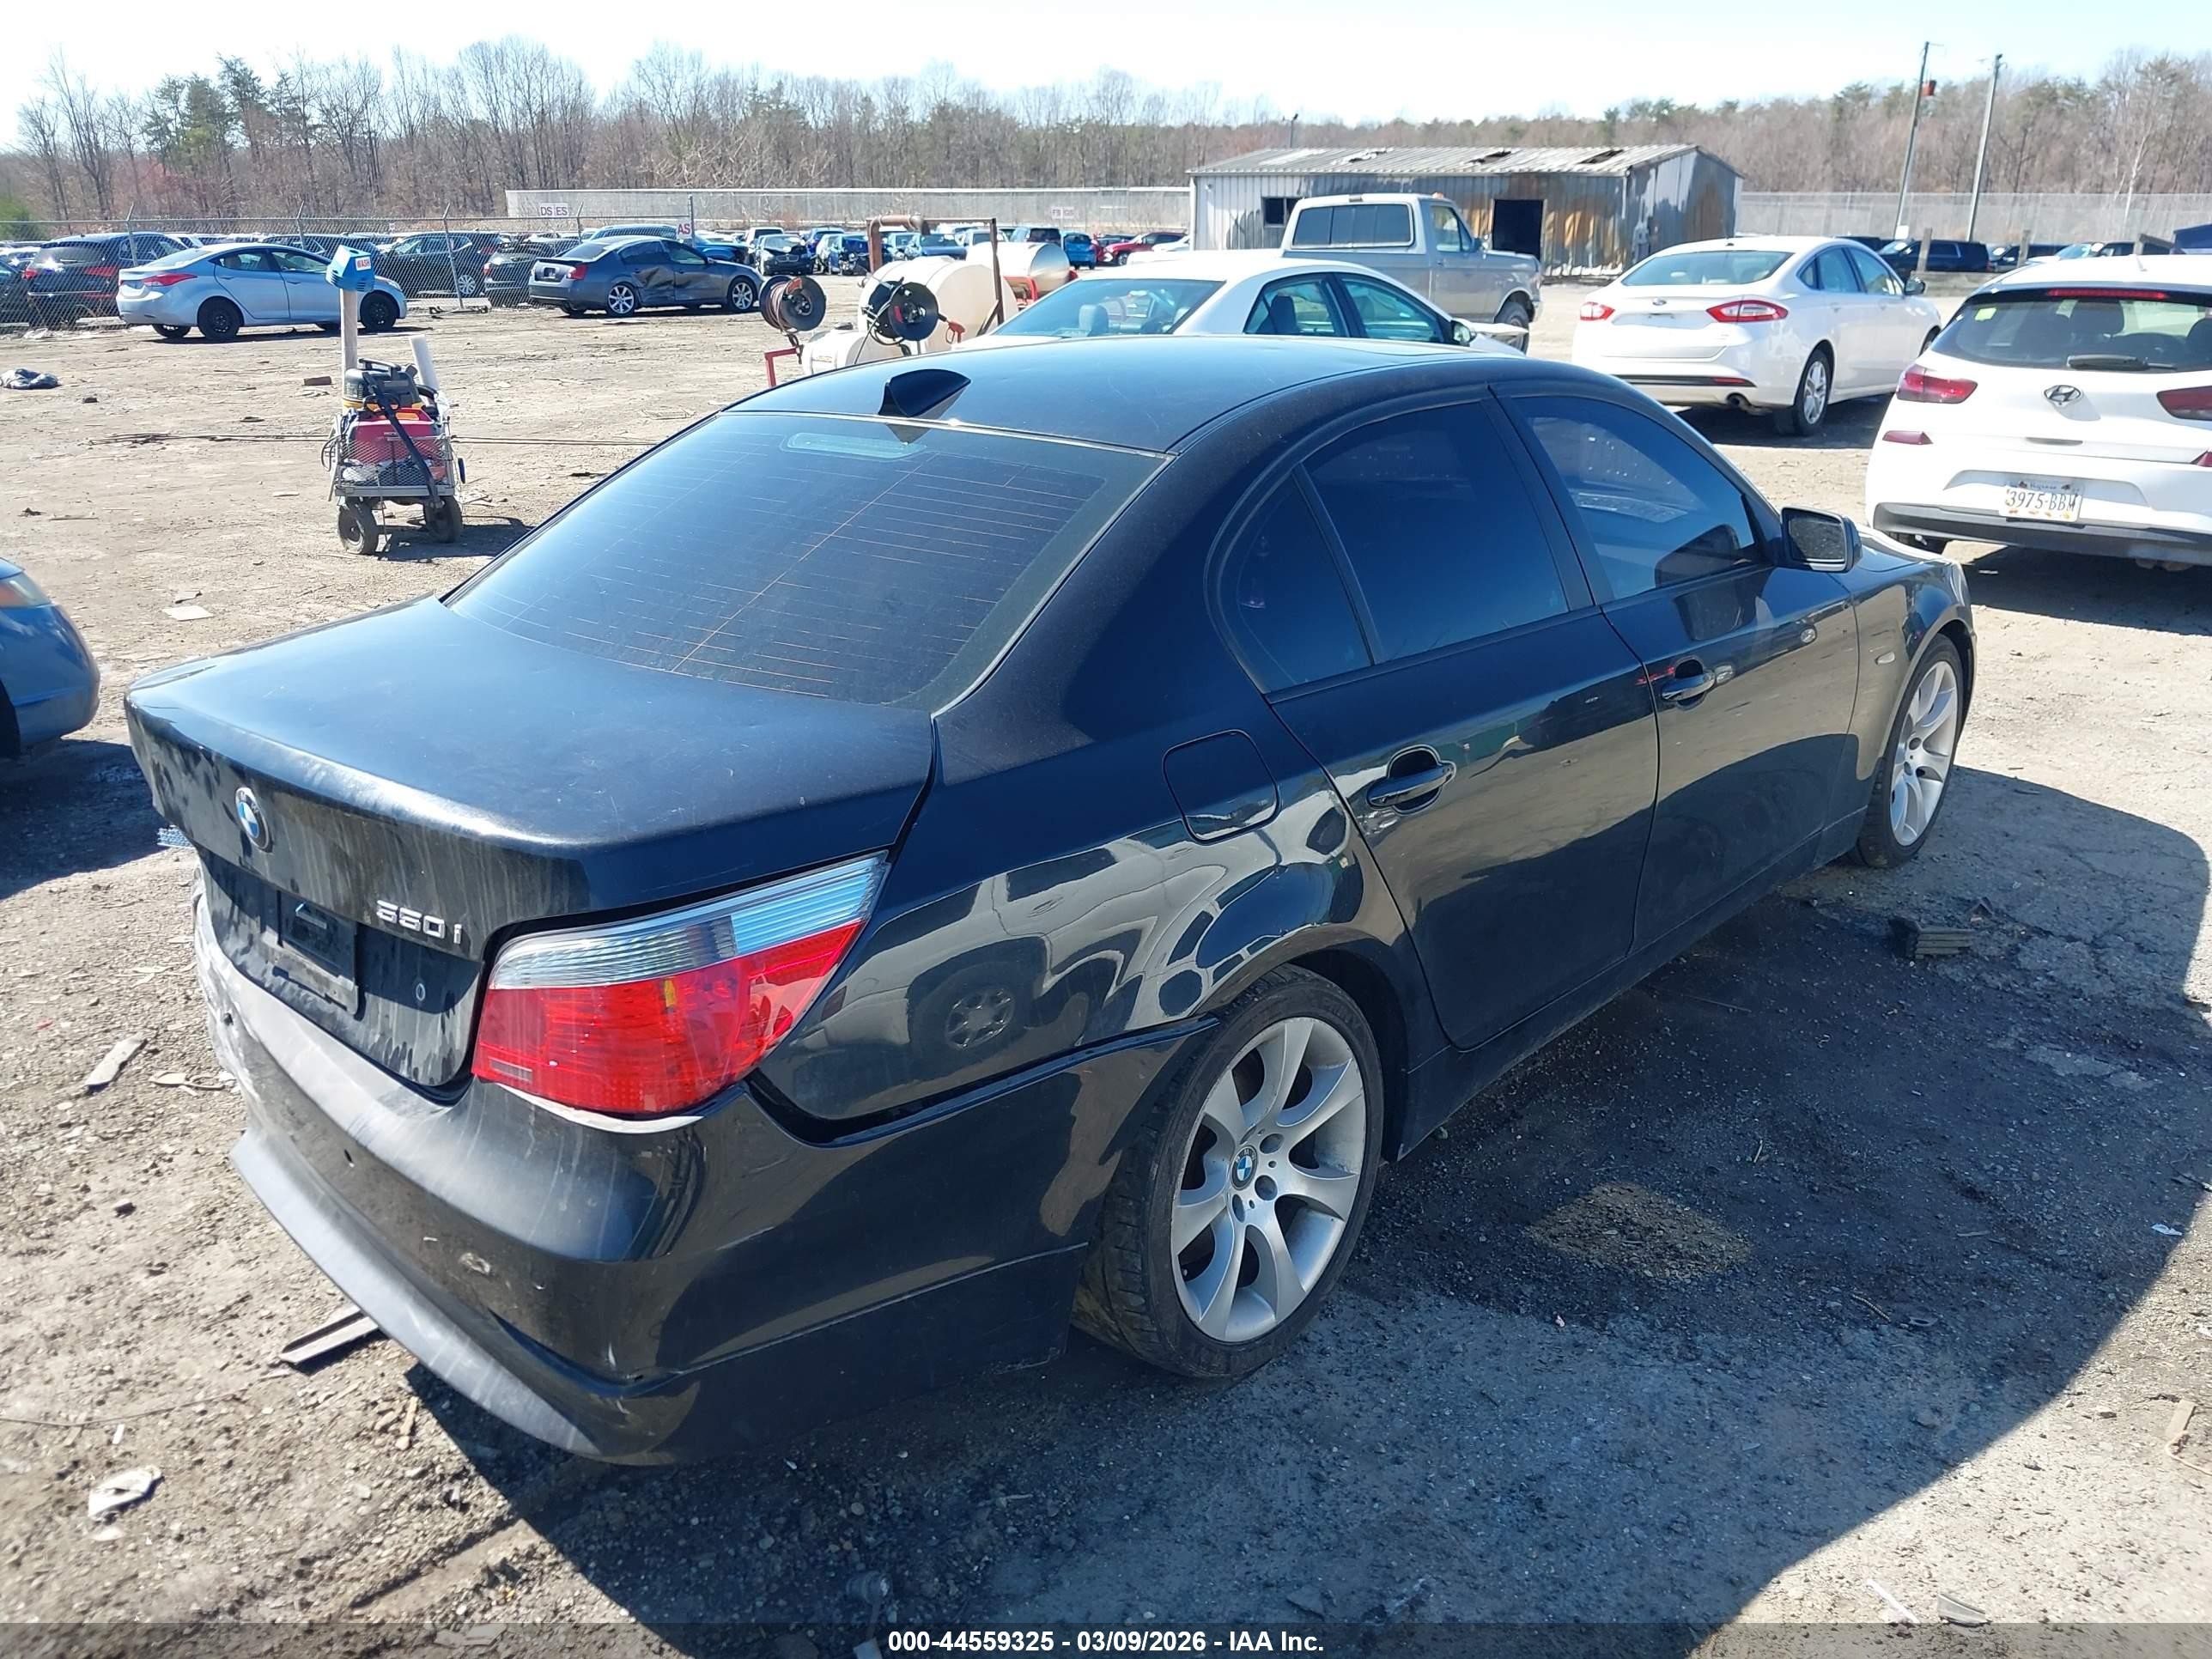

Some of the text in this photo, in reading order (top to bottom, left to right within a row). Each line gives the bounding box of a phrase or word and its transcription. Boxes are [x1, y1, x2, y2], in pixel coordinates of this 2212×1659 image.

[540, 206, 568, 216] DS ES
[678, 224, 690, 234] AS
